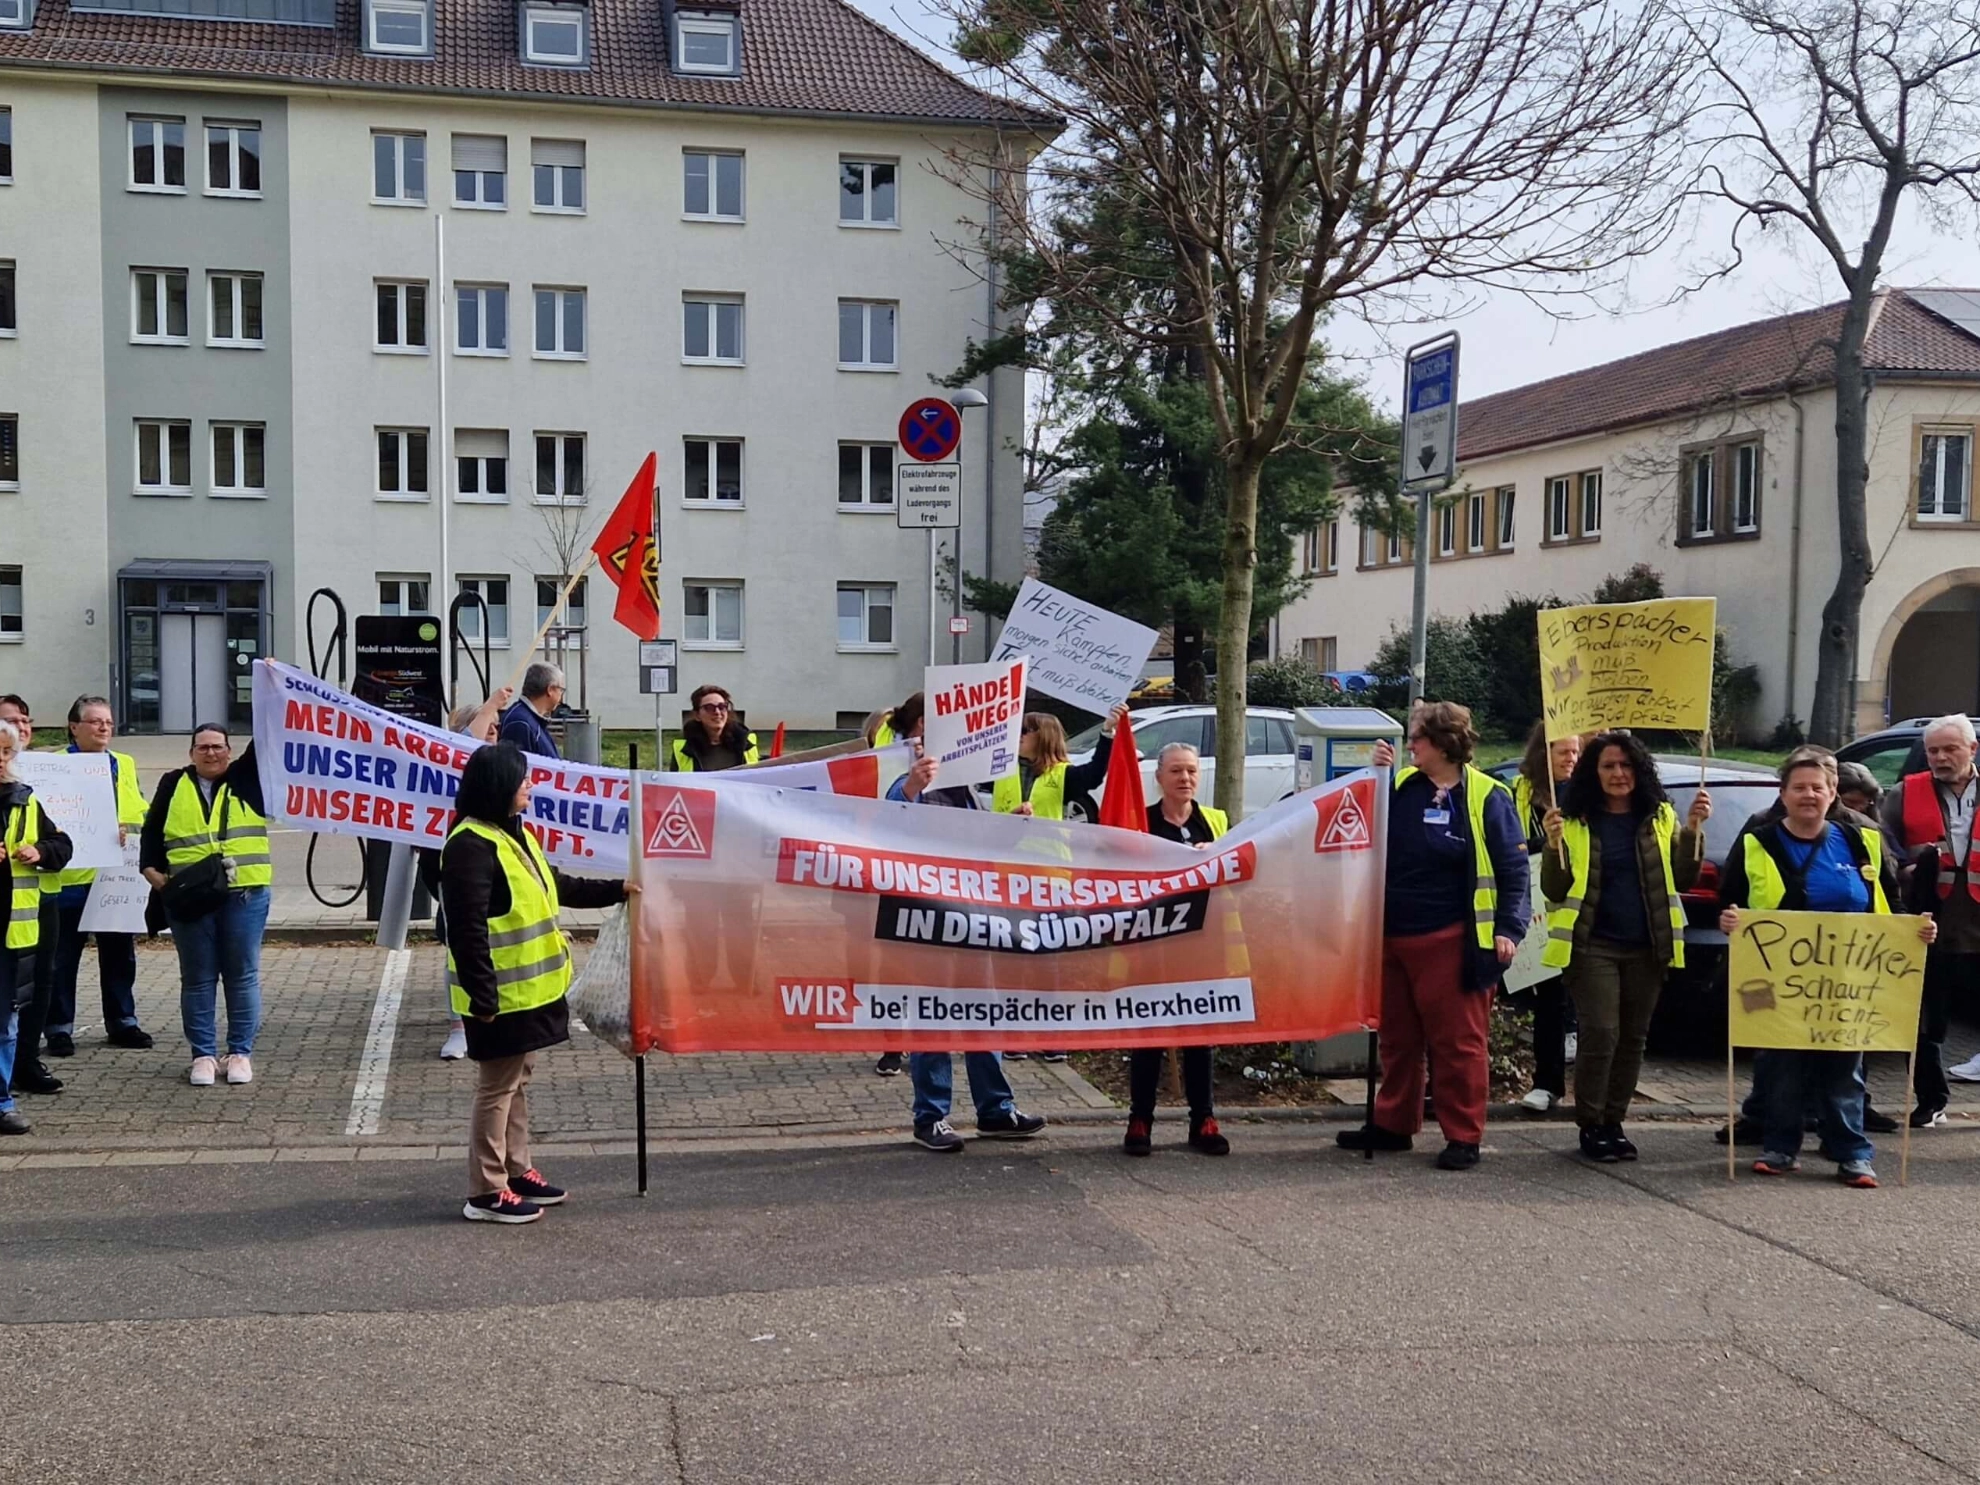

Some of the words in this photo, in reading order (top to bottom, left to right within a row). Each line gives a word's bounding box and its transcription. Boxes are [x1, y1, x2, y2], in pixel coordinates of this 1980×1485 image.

[902, 470, 956, 480] Elektrofahrzeuge
[908, 484, 937, 493] während
[938, 484, 950, 493] des
[907, 499, 951, 508] Ladevorgangs
[920, 512, 938, 523] frei
[85, 609, 95, 625] 3
[1022, 588, 1100, 631] HEUTE
[357, 645, 378, 653] Mobil
[380, 645, 392, 653] mit
[394, 645, 439, 653] Naturstrom.
[1005, 625, 1049, 648] morgen
[1054, 642, 1089, 665] sicher
[1090, 661, 1133, 685] arbeiten
[1075, 678, 1122, 706] bleiben
[1590, 672, 1649, 688] bleiben
[935, 676, 1009, 716] HÄNDE
[284, 699, 373, 743] MEIN
[956, 735, 974, 748] VON
[974, 722, 1008, 741] UNSEREN
[940, 733, 1008, 763] ARBEITSPLÄTZEN!
[284, 741, 397, 789] UNSER
[286, 784, 415, 832] UNSERE
[793, 843, 864, 889] FÜR
[871, 858, 1002, 903] UNSERE
[1008, 850, 1241, 907] PERSPEKTIVE
[895, 908, 936, 940] IN
[941, 911, 1014, 948] DER
[1018, 902, 1191, 952] SÜDPFALZ
[1742, 920, 1921, 979] Politiker
[780, 985, 848, 1016] WIR
[871, 995, 908, 1019] bei
[918, 995, 1075, 1026] Eberspächer
[1084, 998, 1106, 1020] in
[1115, 990, 1241, 1019] Herxheim
[1803, 1003, 1881, 1024] nicht
